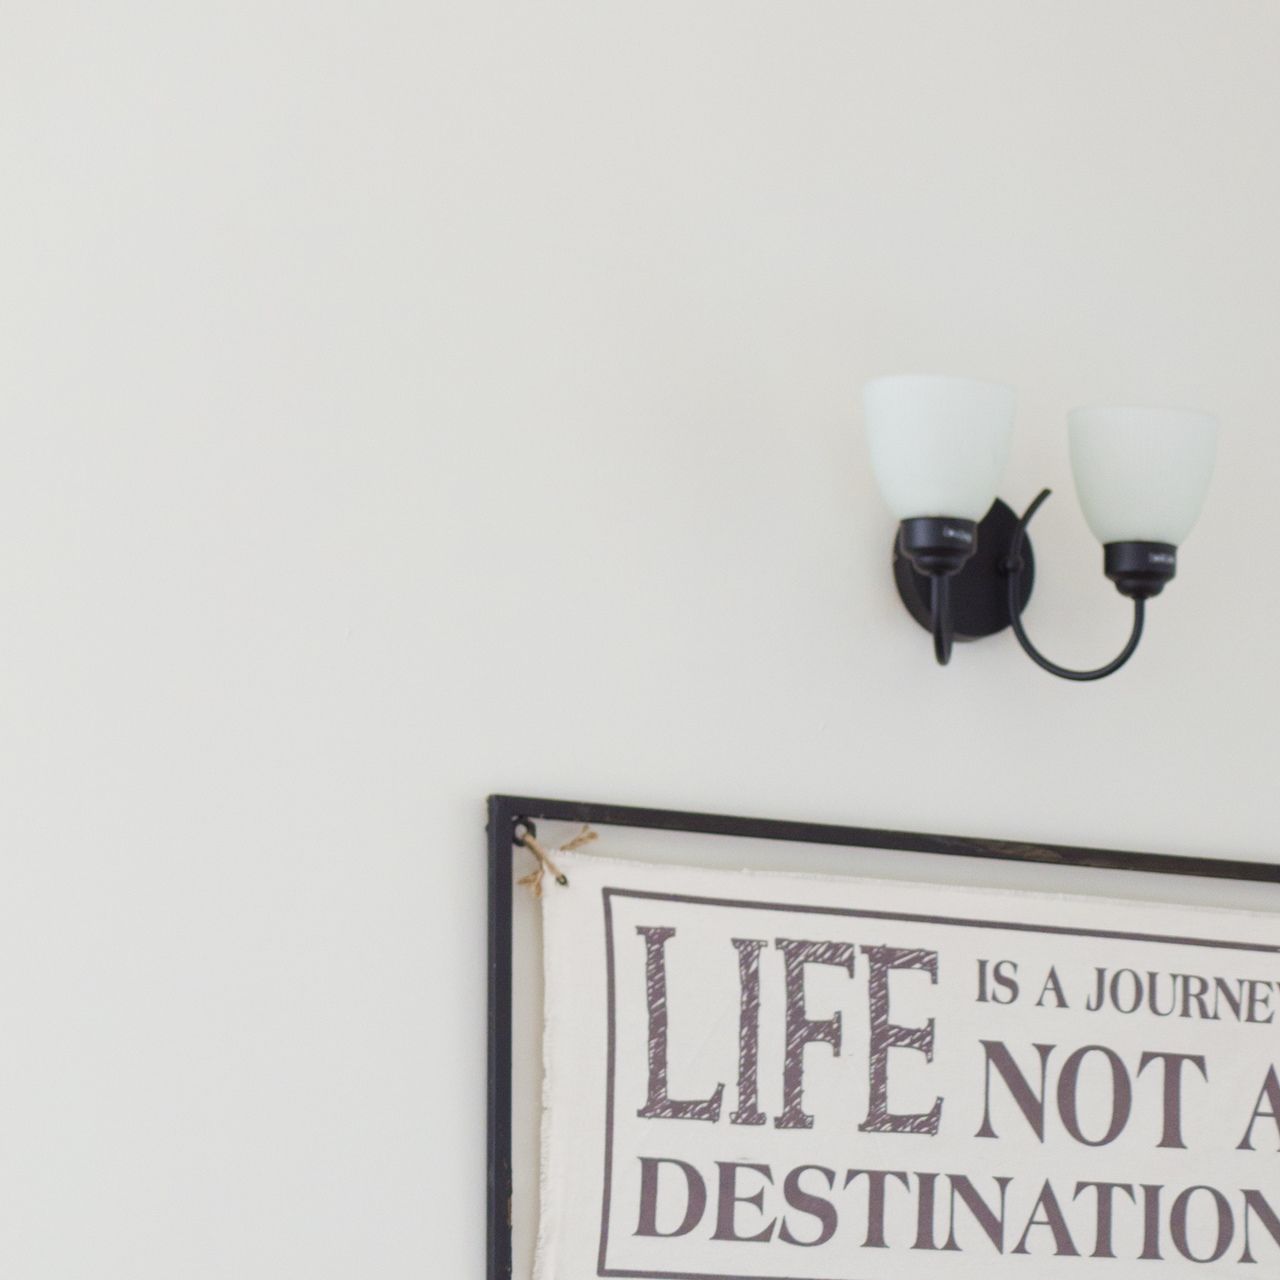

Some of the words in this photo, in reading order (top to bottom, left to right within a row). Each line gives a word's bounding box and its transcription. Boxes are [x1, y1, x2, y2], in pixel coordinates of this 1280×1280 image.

[636, 924, 940, 1135] LIFE
[975, 959, 1019, 1005] IS
[1034, 968, 1069, 1010] A
[974, 1040, 1208, 1150] NOT
